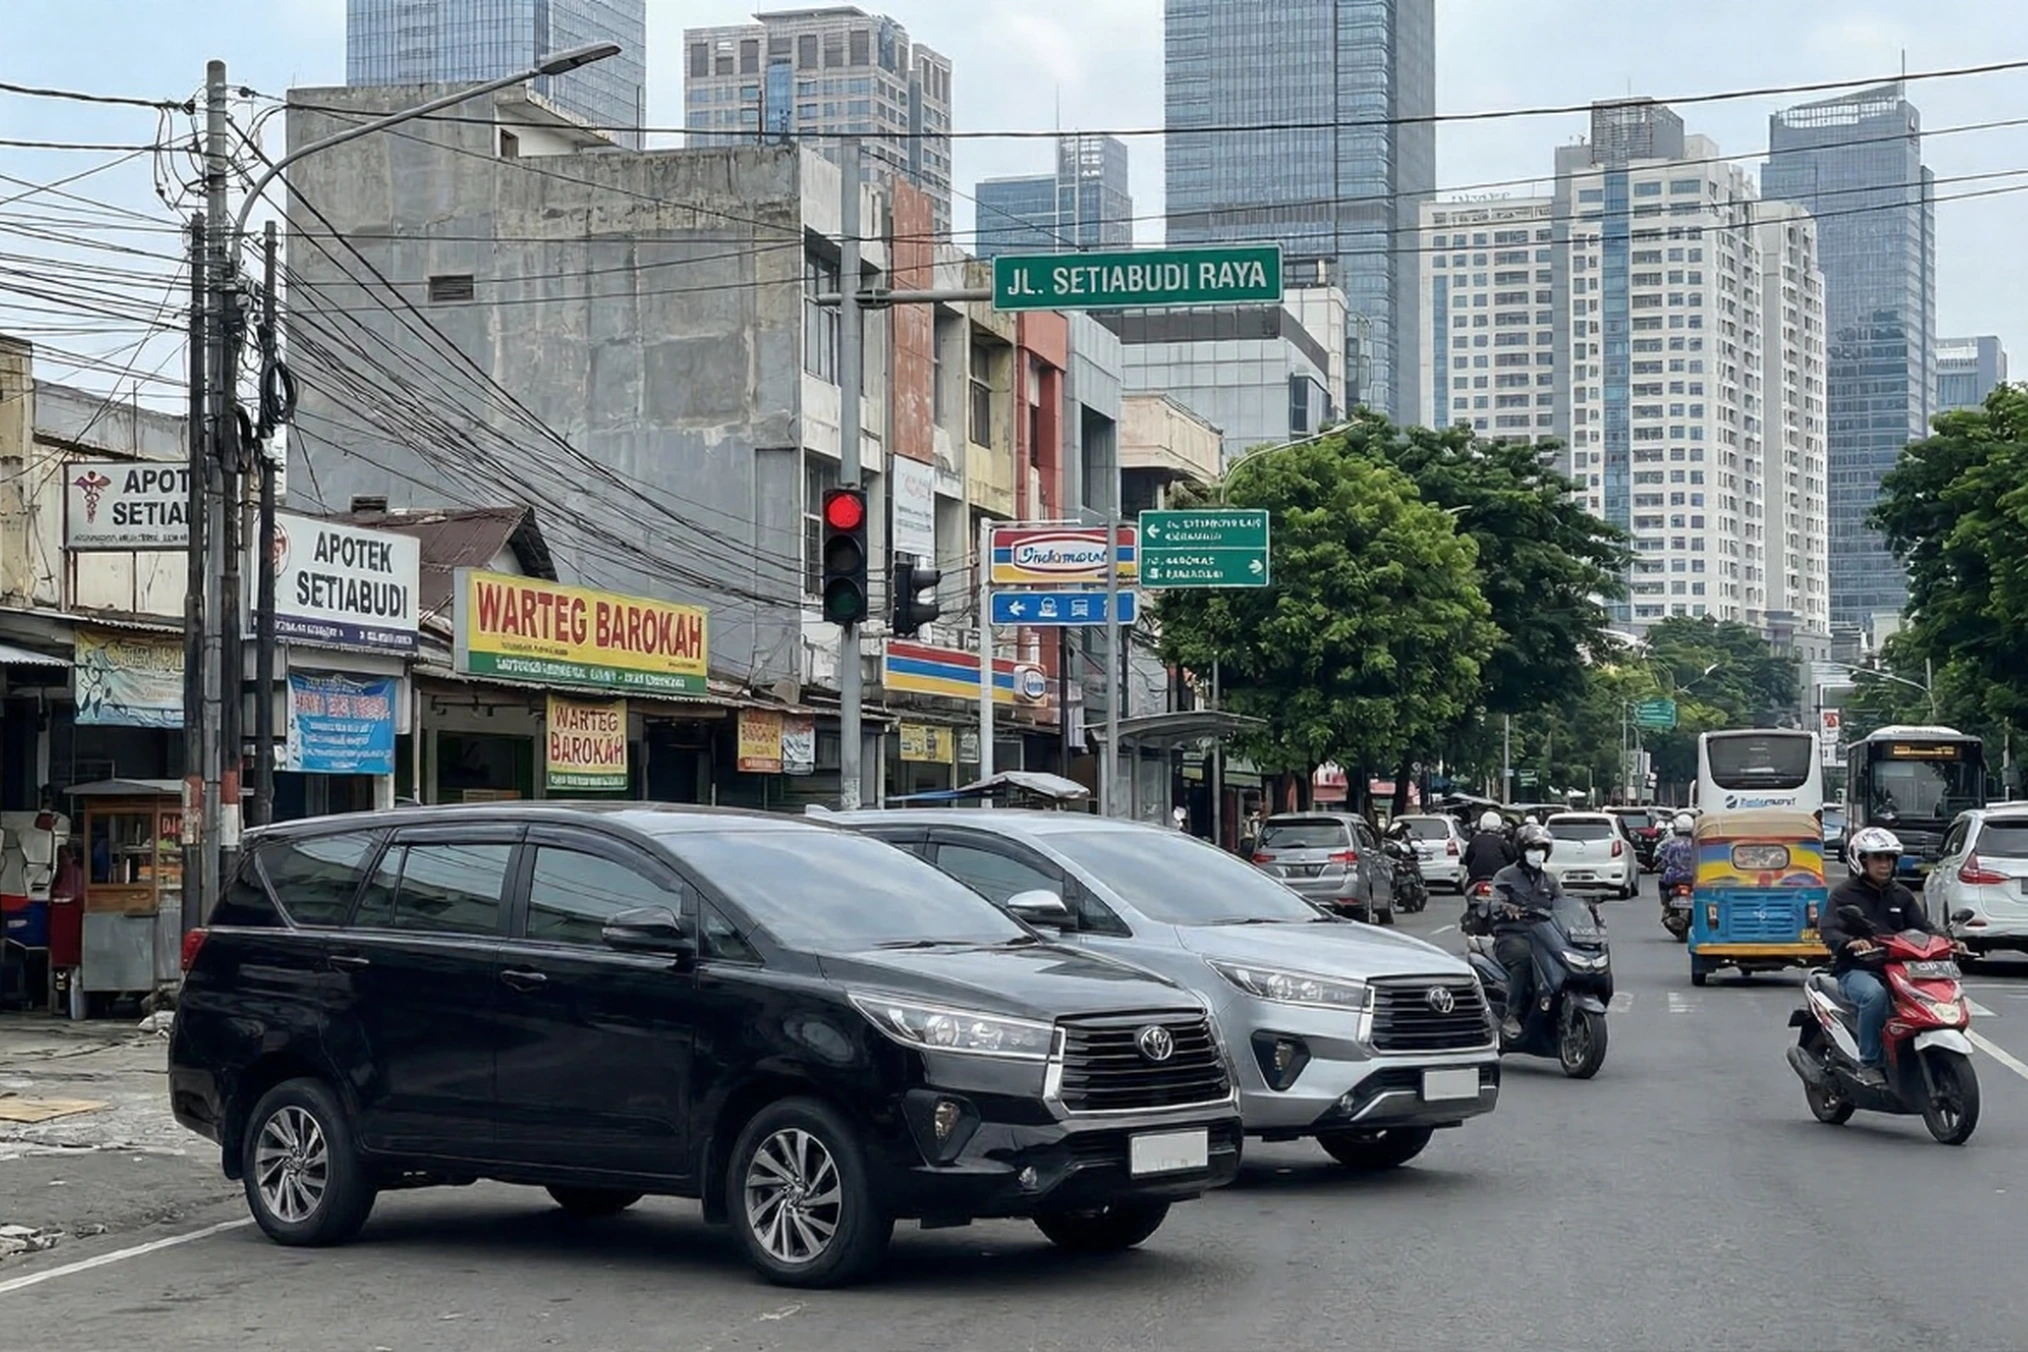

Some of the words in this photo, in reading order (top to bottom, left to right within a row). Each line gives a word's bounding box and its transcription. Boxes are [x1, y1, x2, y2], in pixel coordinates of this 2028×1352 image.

[1007, 268, 1043, 295] JL.
[1053, 263, 1189, 294] SETIABUDI
[1199, 260, 1266, 289] RAYA
[123, 468, 190, 494] APOT
[112, 501, 190, 525] SETIA
[314, 531, 392, 574] APOTEK
[296, 569, 407, 619] SETIABUDI
[476, 581, 587, 645] WARTEG
[595, 601, 702, 660] BAROKAH
[550, 731, 624, 765] BAROKAH
